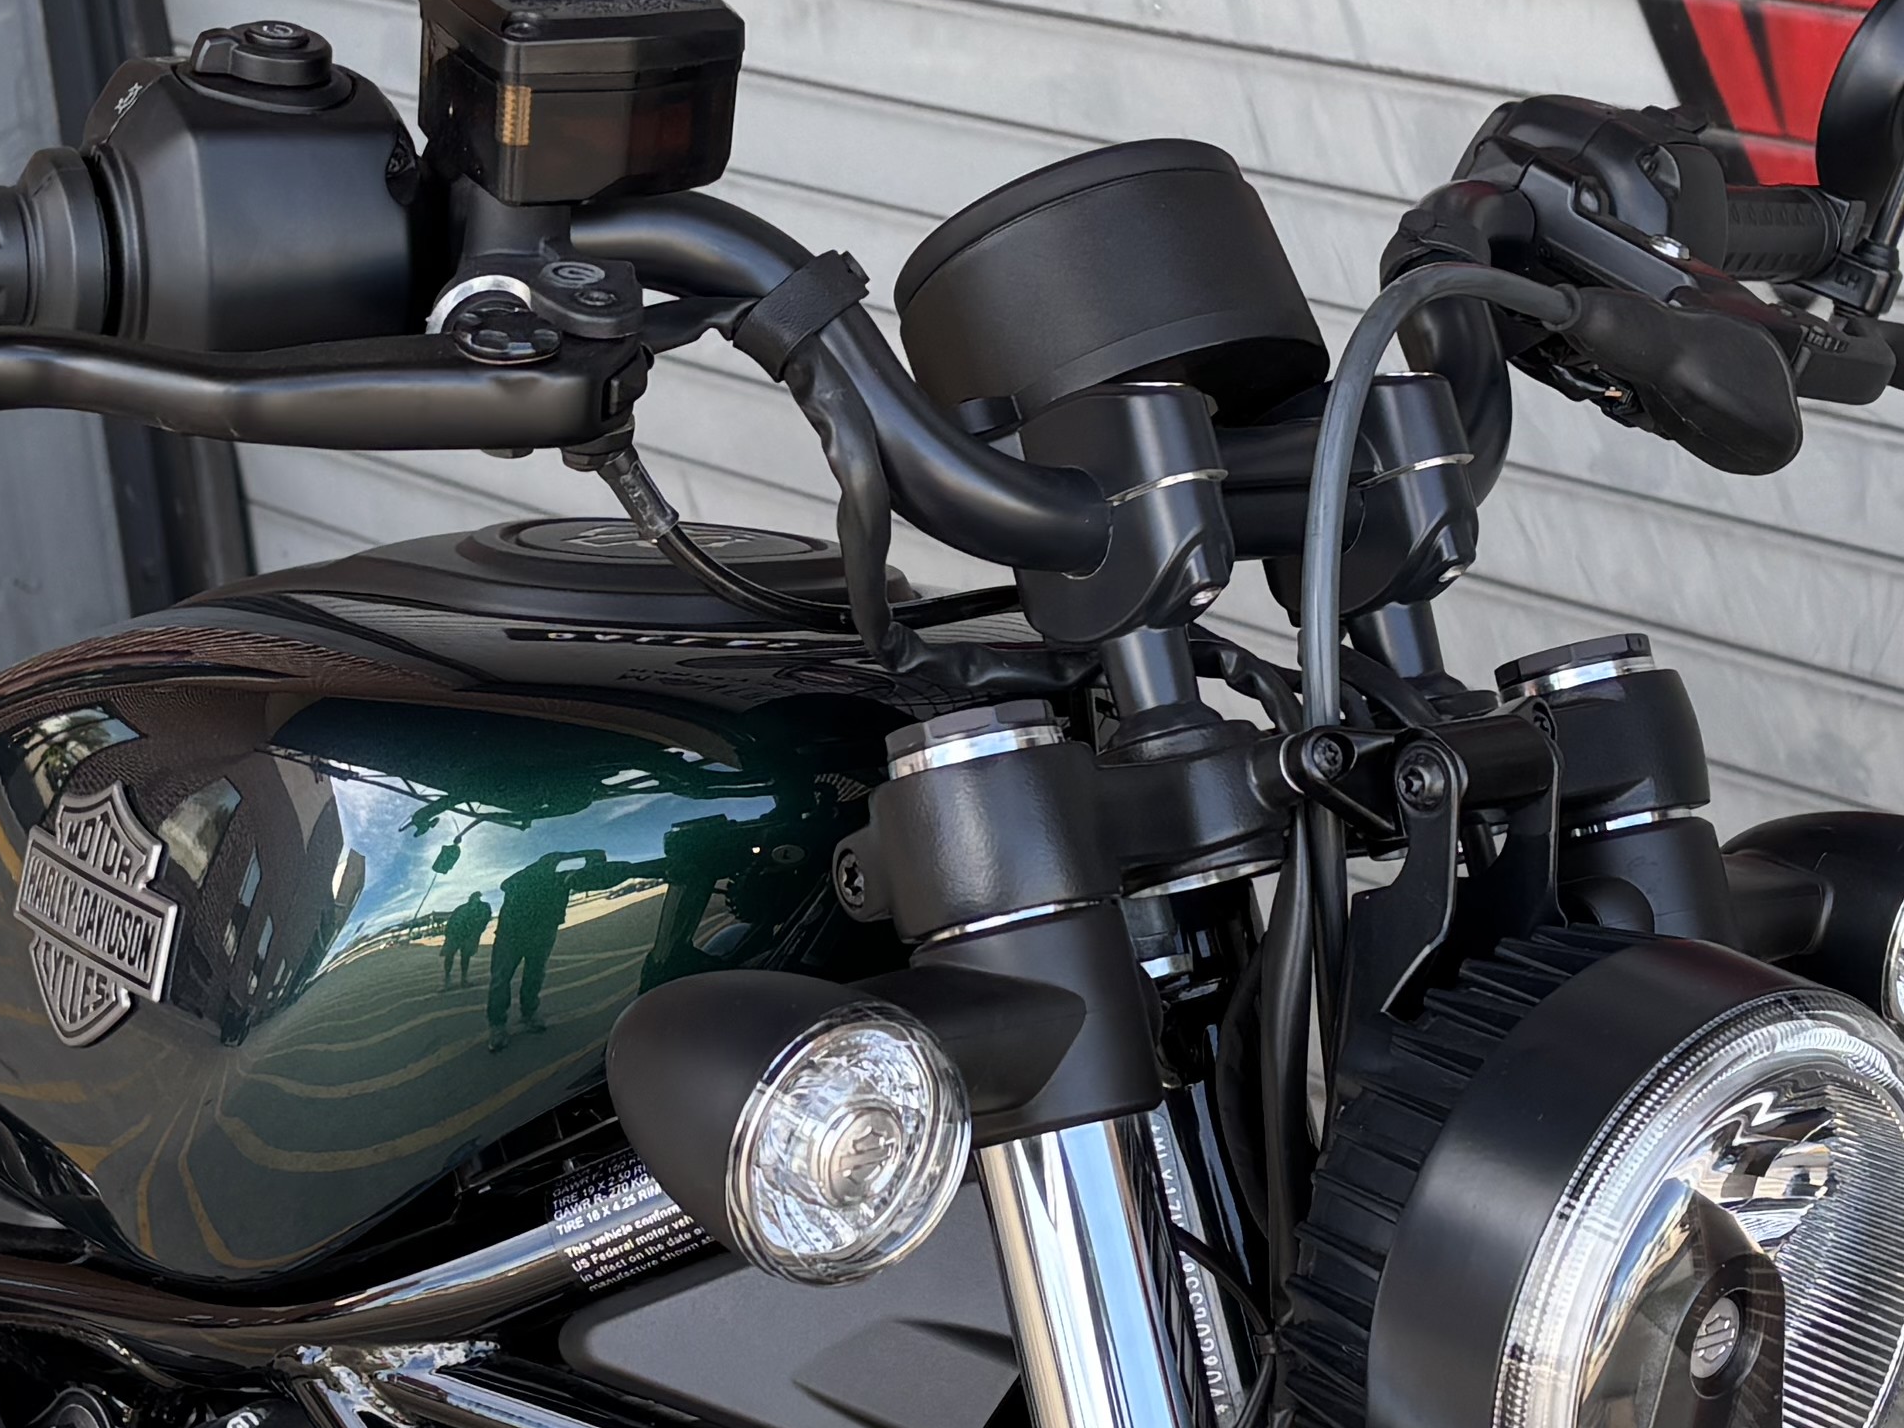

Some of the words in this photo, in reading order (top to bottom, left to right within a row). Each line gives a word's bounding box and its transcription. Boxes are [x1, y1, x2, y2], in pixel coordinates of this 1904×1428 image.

[63, 811, 134, 886] MOTOR
[23, 855, 155, 973] HARLEY-DAVIDSON
[39, 940, 109, 1025] CYCLES
[552, 1191, 579, 1210] TIRE
[597, 1181, 606, 1192] X
[553, 1197, 592, 1222] GAWR
[556, 1215, 585, 1236] TIRE
[601, 1205, 612, 1218] X
[563, 1241, 592, 1259] This
[591, 1224, 633, 1248] vehicle
[636, 1204, 683, 1229] conform
[571, 1258, 591, 1272] US
[590, 1239, 634, 1264] Federal
[636, 1226, 670, 1247] motor
[671, 1215, 695, 1231] veh
[594, 1259, 628, 1278] effect
[629, 1251, 645, 1264] on
[645, 1243, 665, 1257] the
[666, 1231, 692, 1248] date
